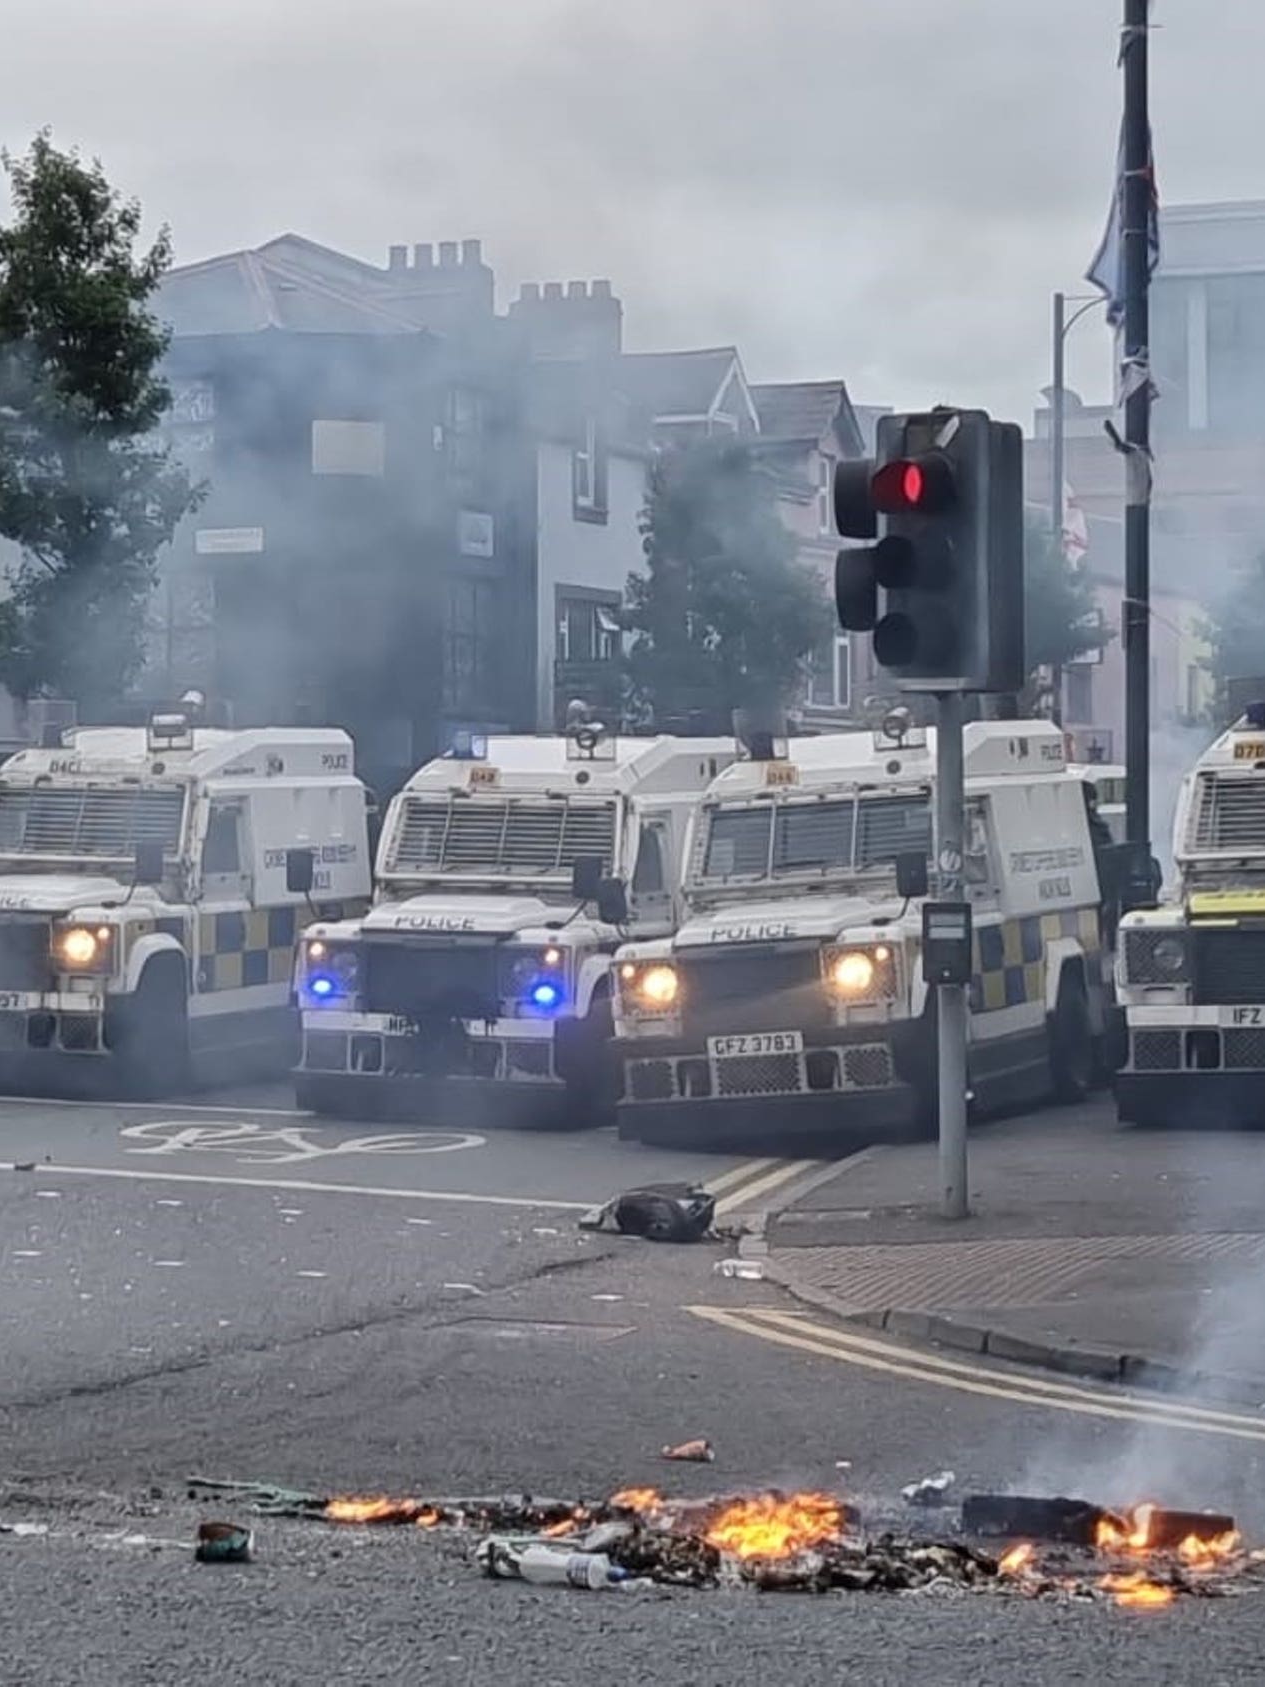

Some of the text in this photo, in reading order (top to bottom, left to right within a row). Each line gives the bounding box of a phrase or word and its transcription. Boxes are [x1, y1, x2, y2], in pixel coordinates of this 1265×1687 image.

[395, 916, 475, 930] POLICE
[711, 924, 796, 941] POLICE
[715, 1037, 747, 1055] GFZ
